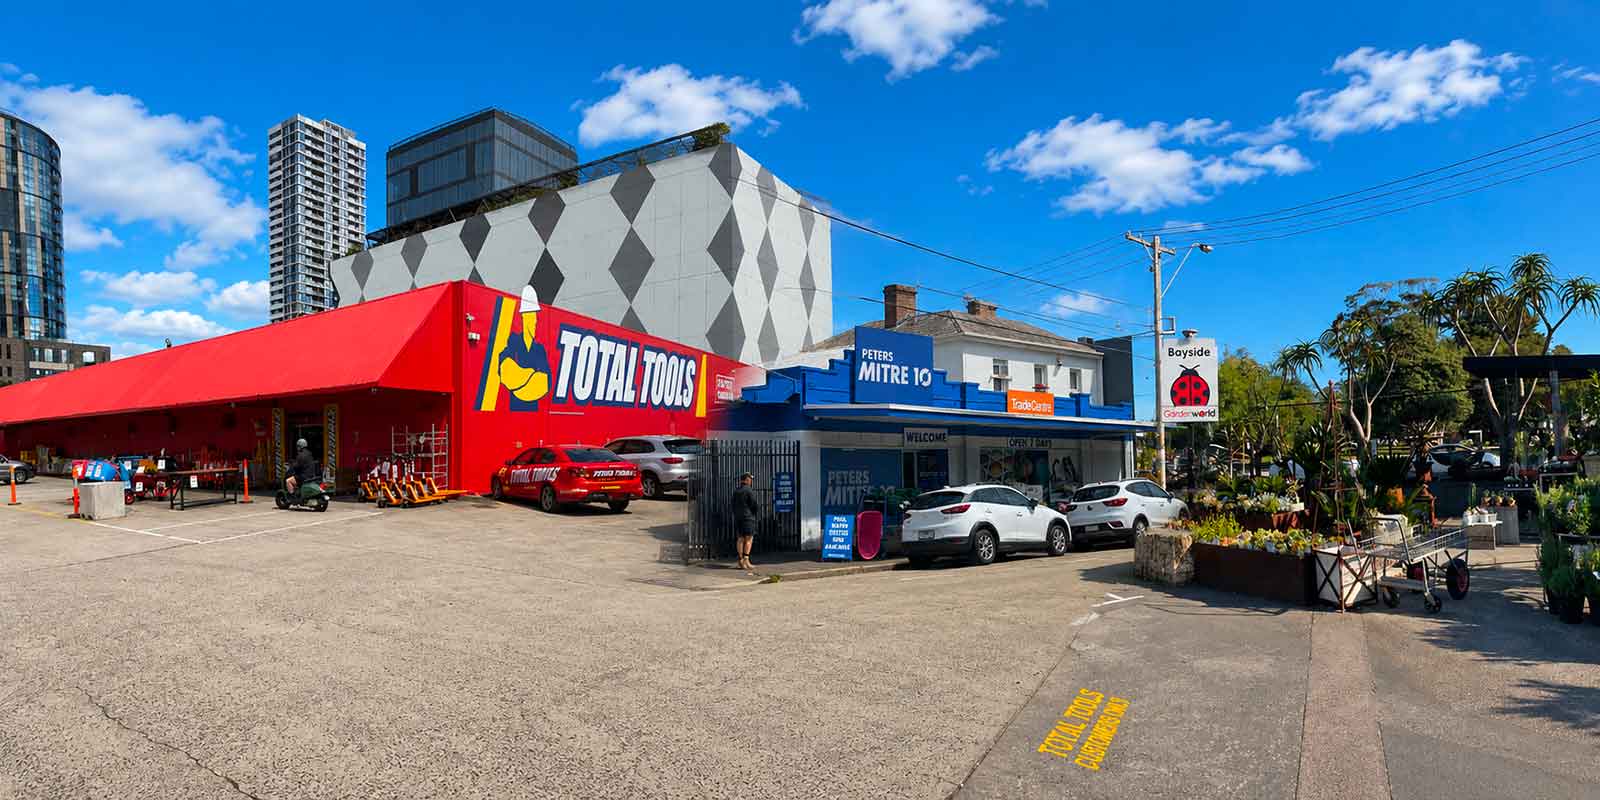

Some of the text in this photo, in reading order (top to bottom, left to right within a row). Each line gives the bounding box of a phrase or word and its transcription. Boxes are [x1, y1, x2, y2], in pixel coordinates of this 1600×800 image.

[862, 348, 893, 361] PETERS
[1168, 347, 1211, 359] Bayside
[555, 330, 696, 408] TOTAL TOOLS
[858, 361, 932, 387] MITRE 10
[905, 431, 947, 442] WELCOME
[828, 470, 870, 485] PETERS
[1038, 688, 1104, 758] TOTAL TOOLS
